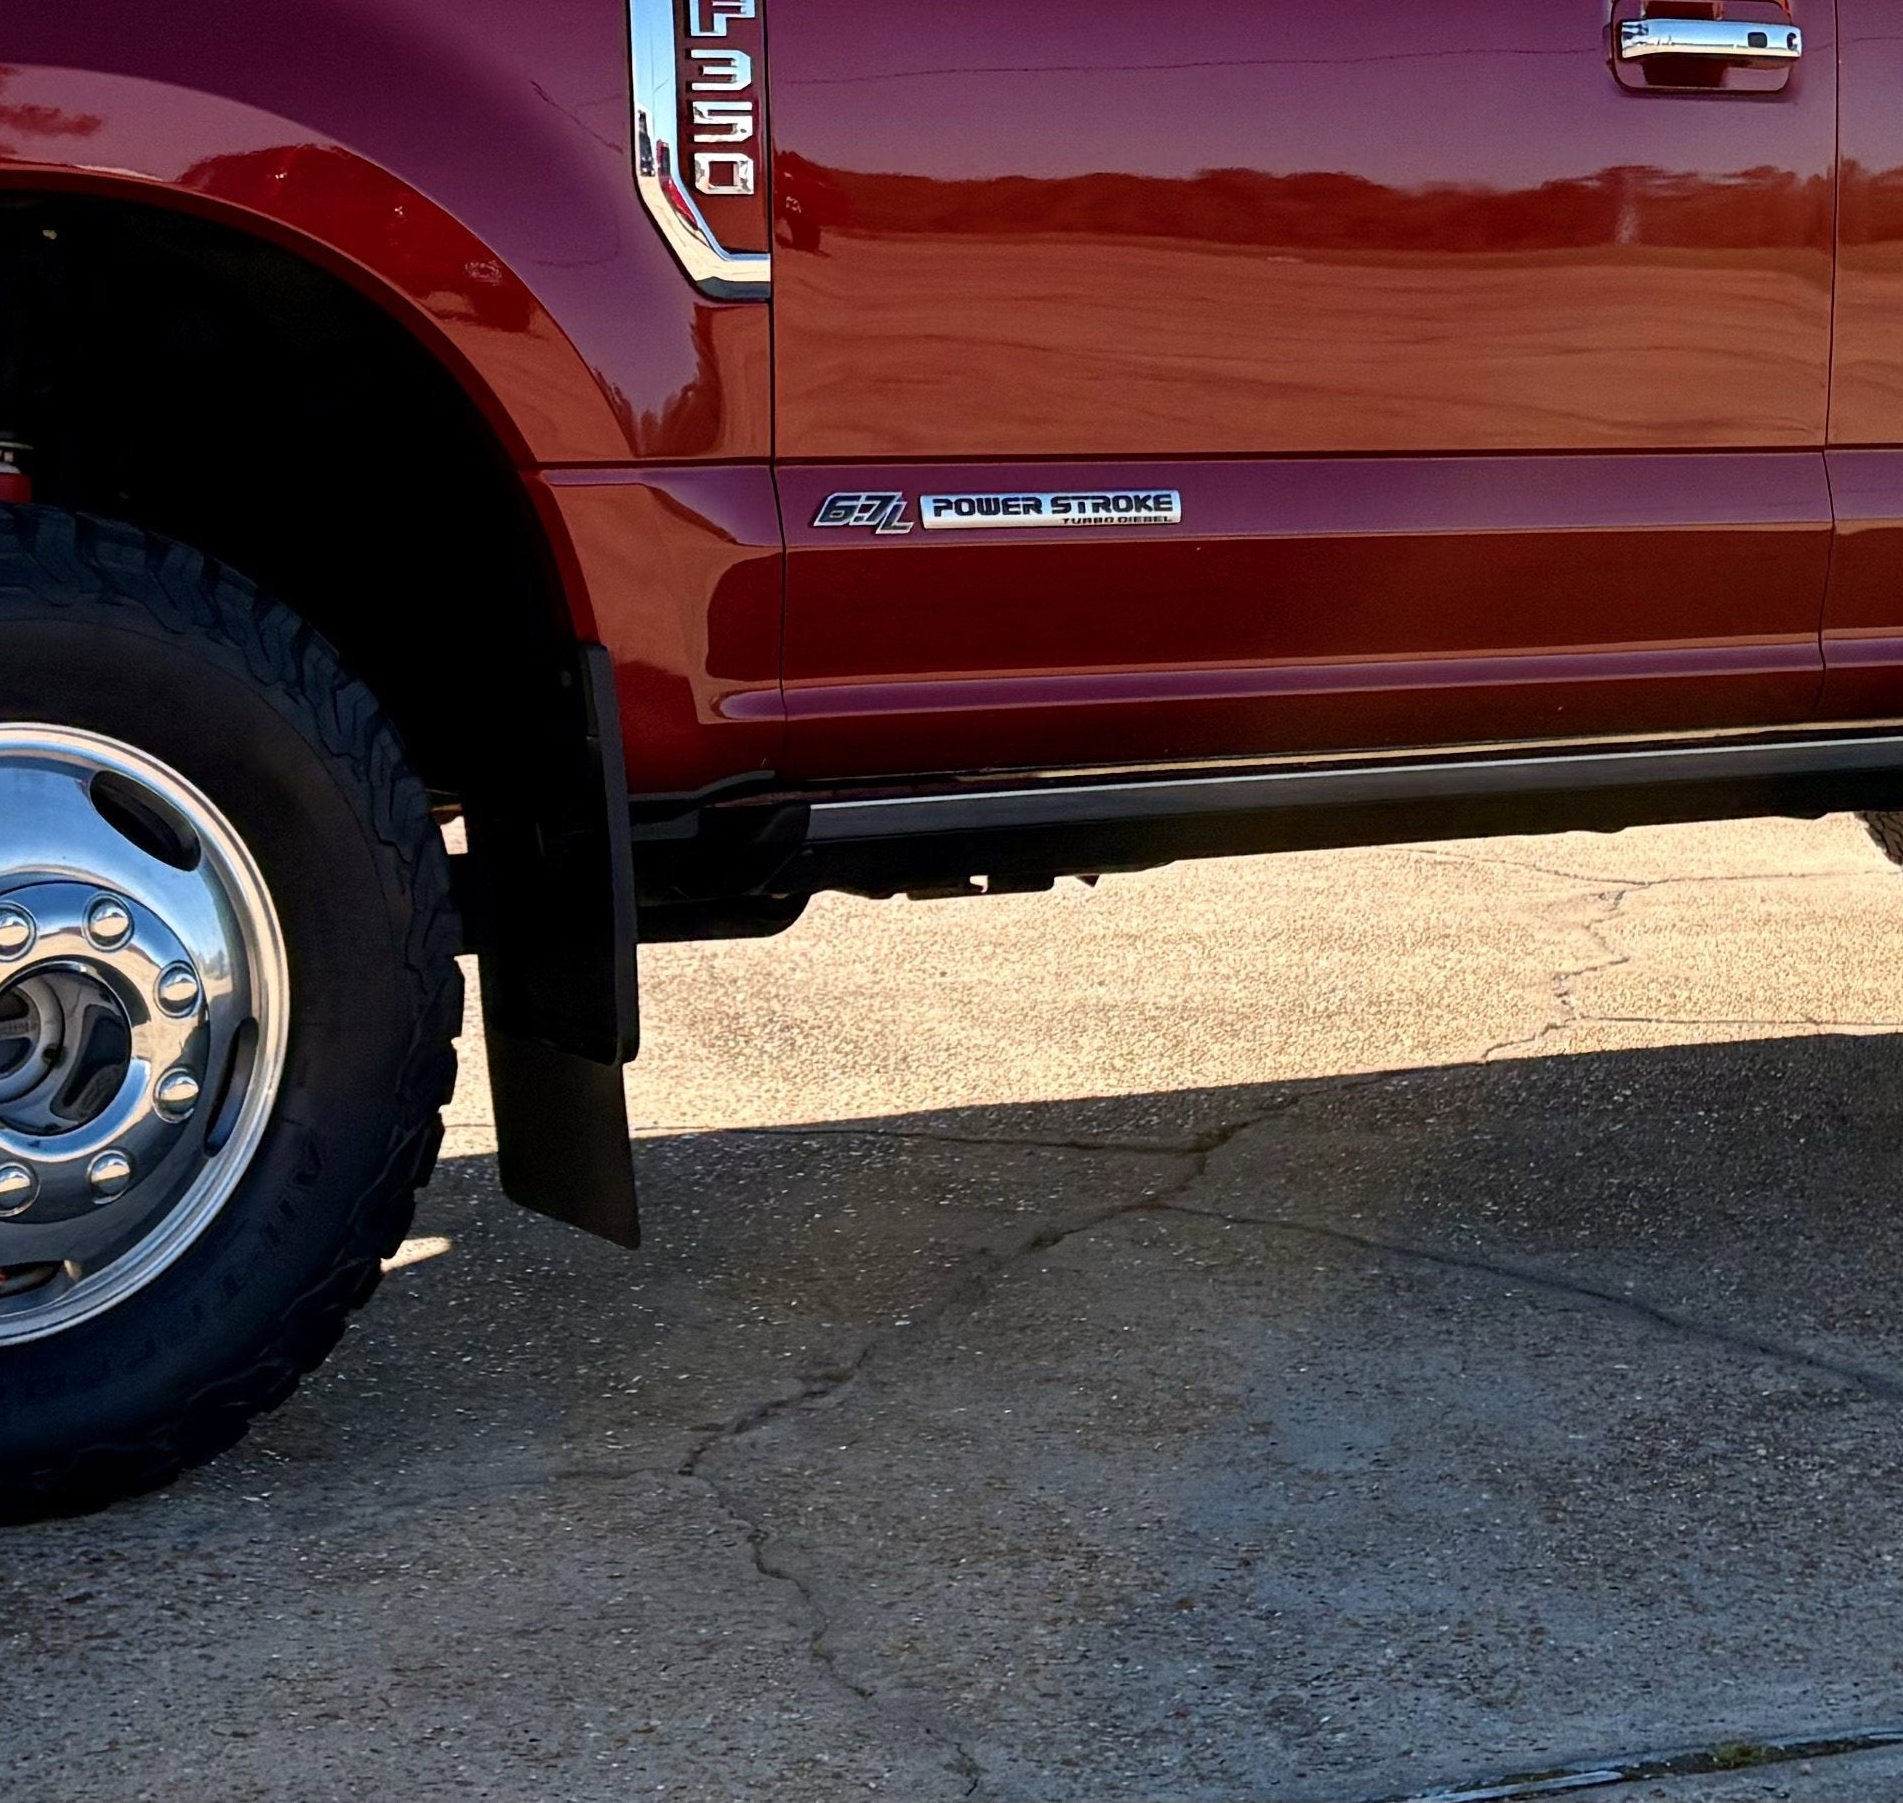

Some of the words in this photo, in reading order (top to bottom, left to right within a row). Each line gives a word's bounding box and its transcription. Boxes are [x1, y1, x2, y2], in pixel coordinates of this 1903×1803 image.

[813, 491, 914, 535] 6.7L
[932, 495, 1043, 518] POWER
[1050, 493, 1174, 514] STROKE
[1061, 516, 1115, 524] TURBO
[1117, 515, 1173, 523] DIESEL
